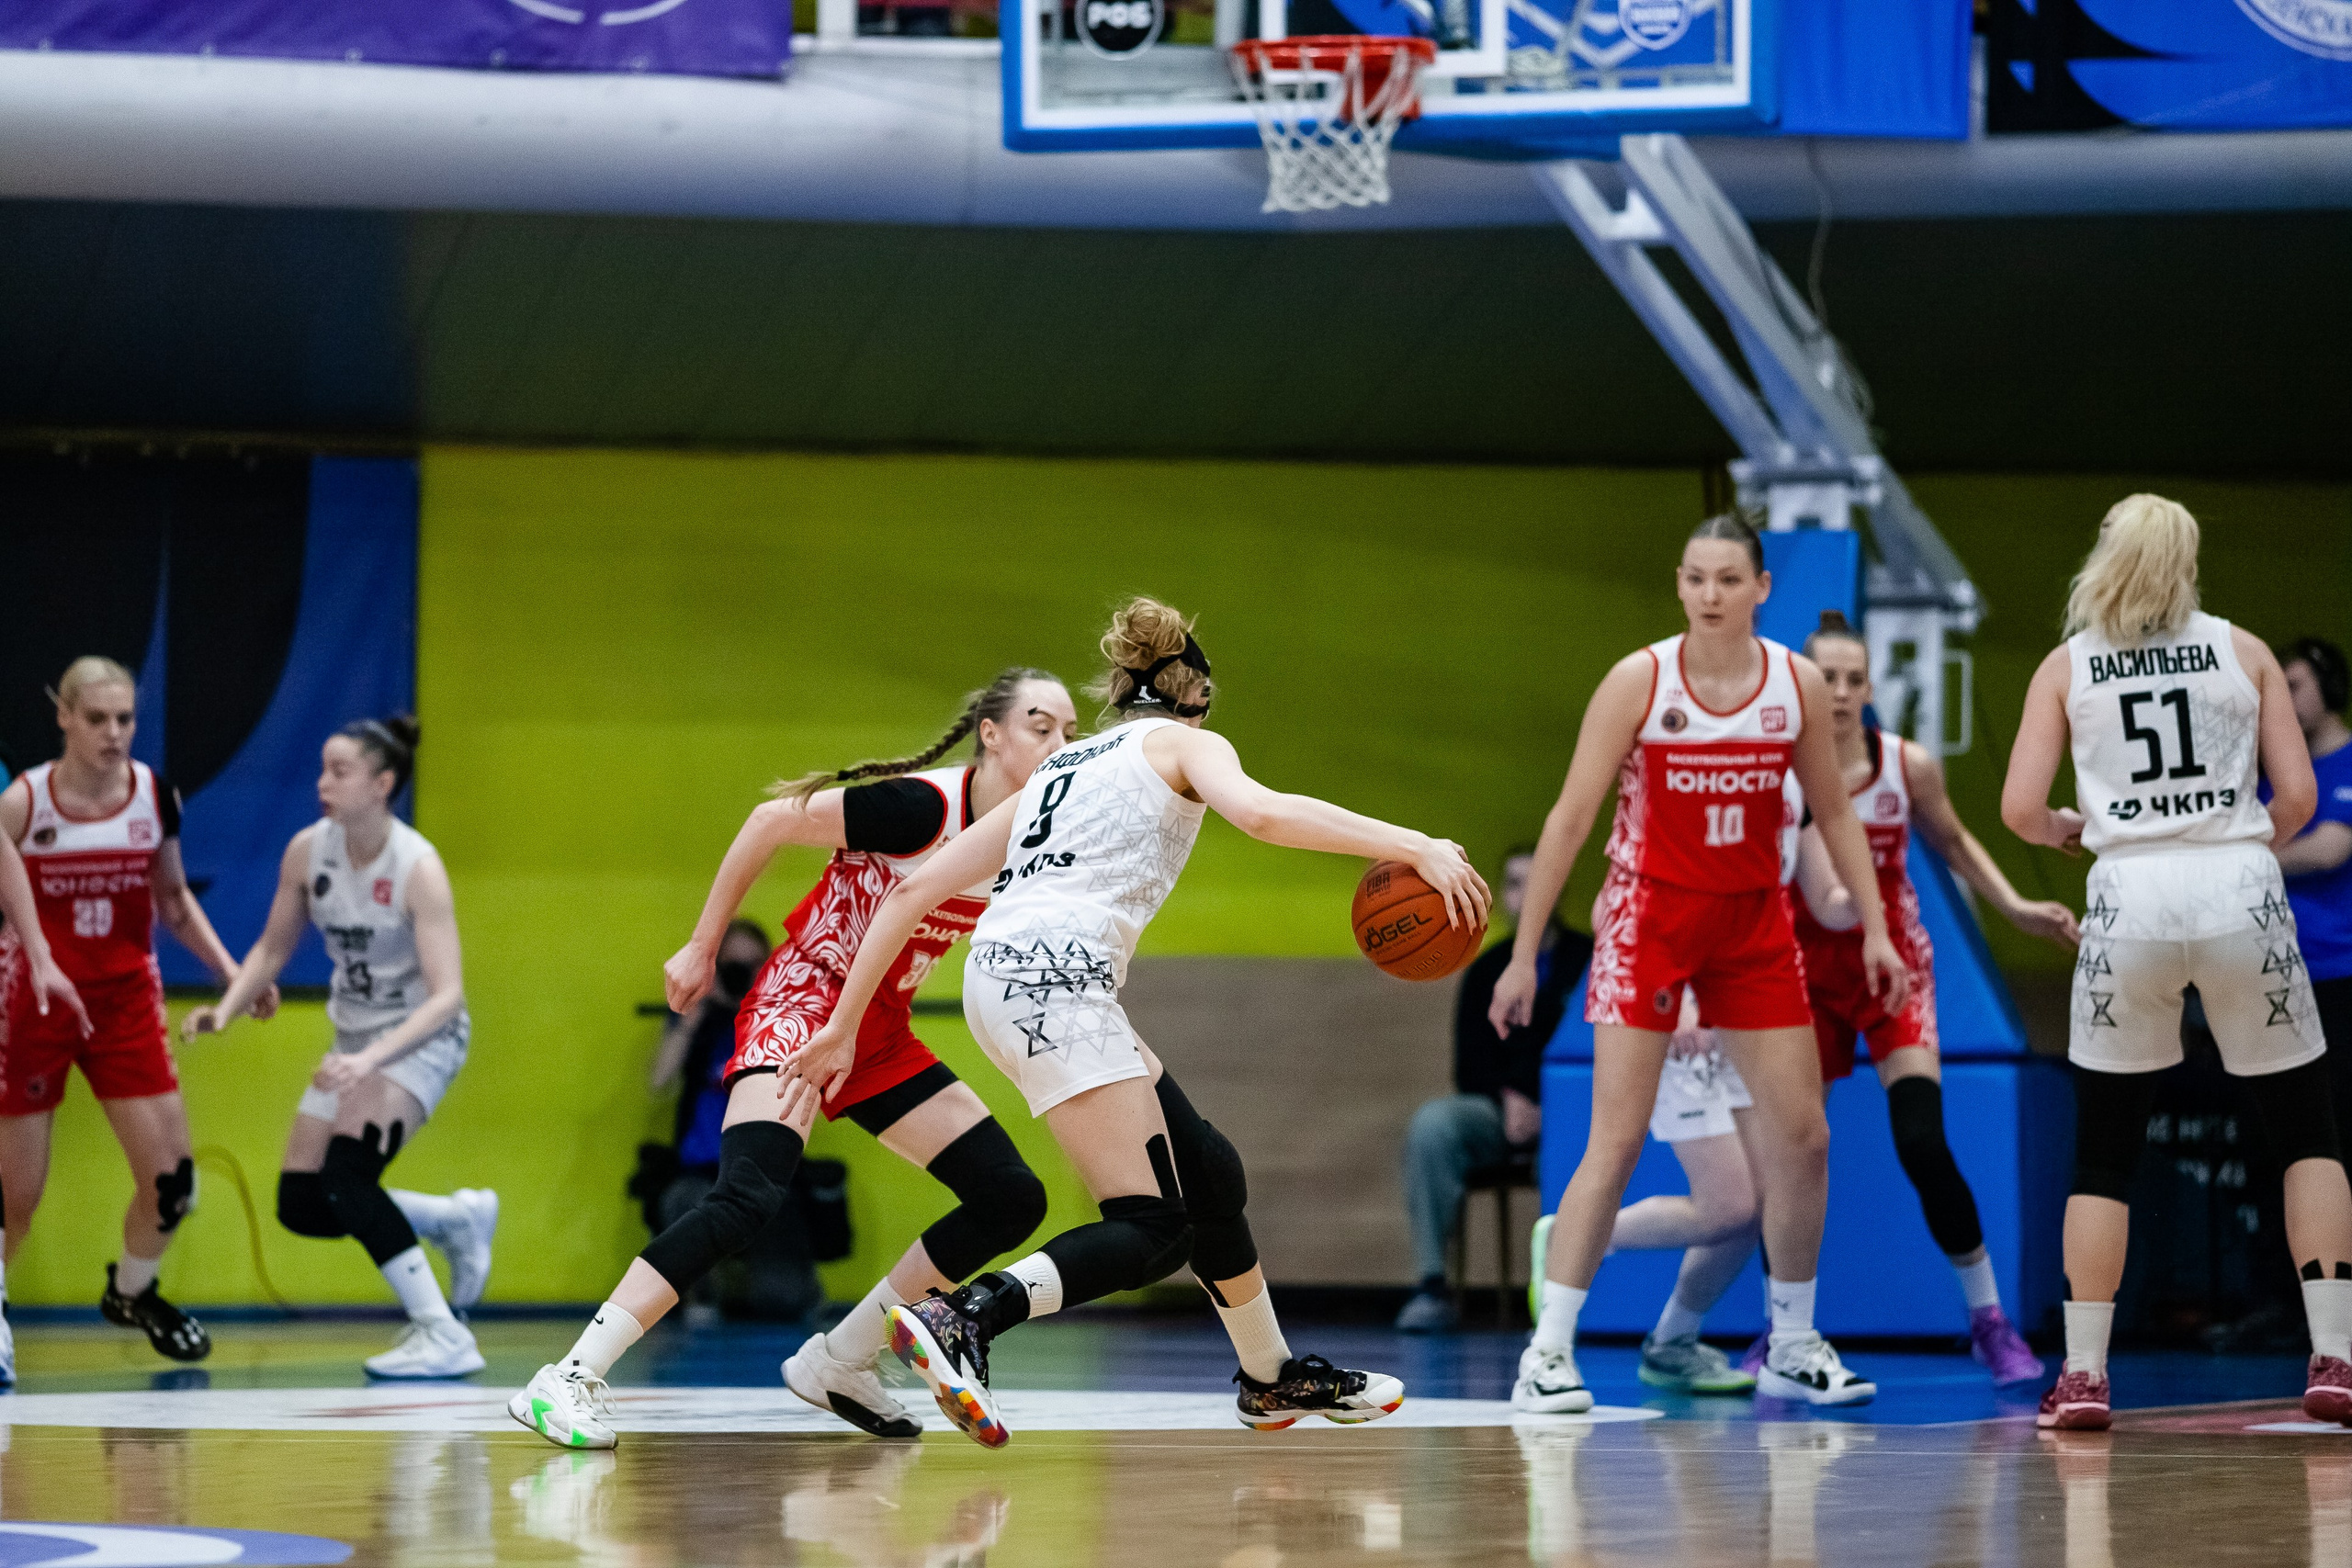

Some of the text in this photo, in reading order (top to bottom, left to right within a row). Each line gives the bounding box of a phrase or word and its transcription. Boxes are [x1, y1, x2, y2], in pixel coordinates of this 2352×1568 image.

[2089, 644, 2220, 683] ВАСИЛЬЕВА
[2120, 688, 2206, 783] 51
[1666, 769, 1782, 794] ЮНОСТЬ
[1020, 771, 1077, 849] 9
[2151, 788, 2235, 817] ЧКПЗ
[1704, 803, 1745, 847] 10
[1366, 872, 1391, 893] FIBA
[1364, 912, 1433, 952] JÖGEL
